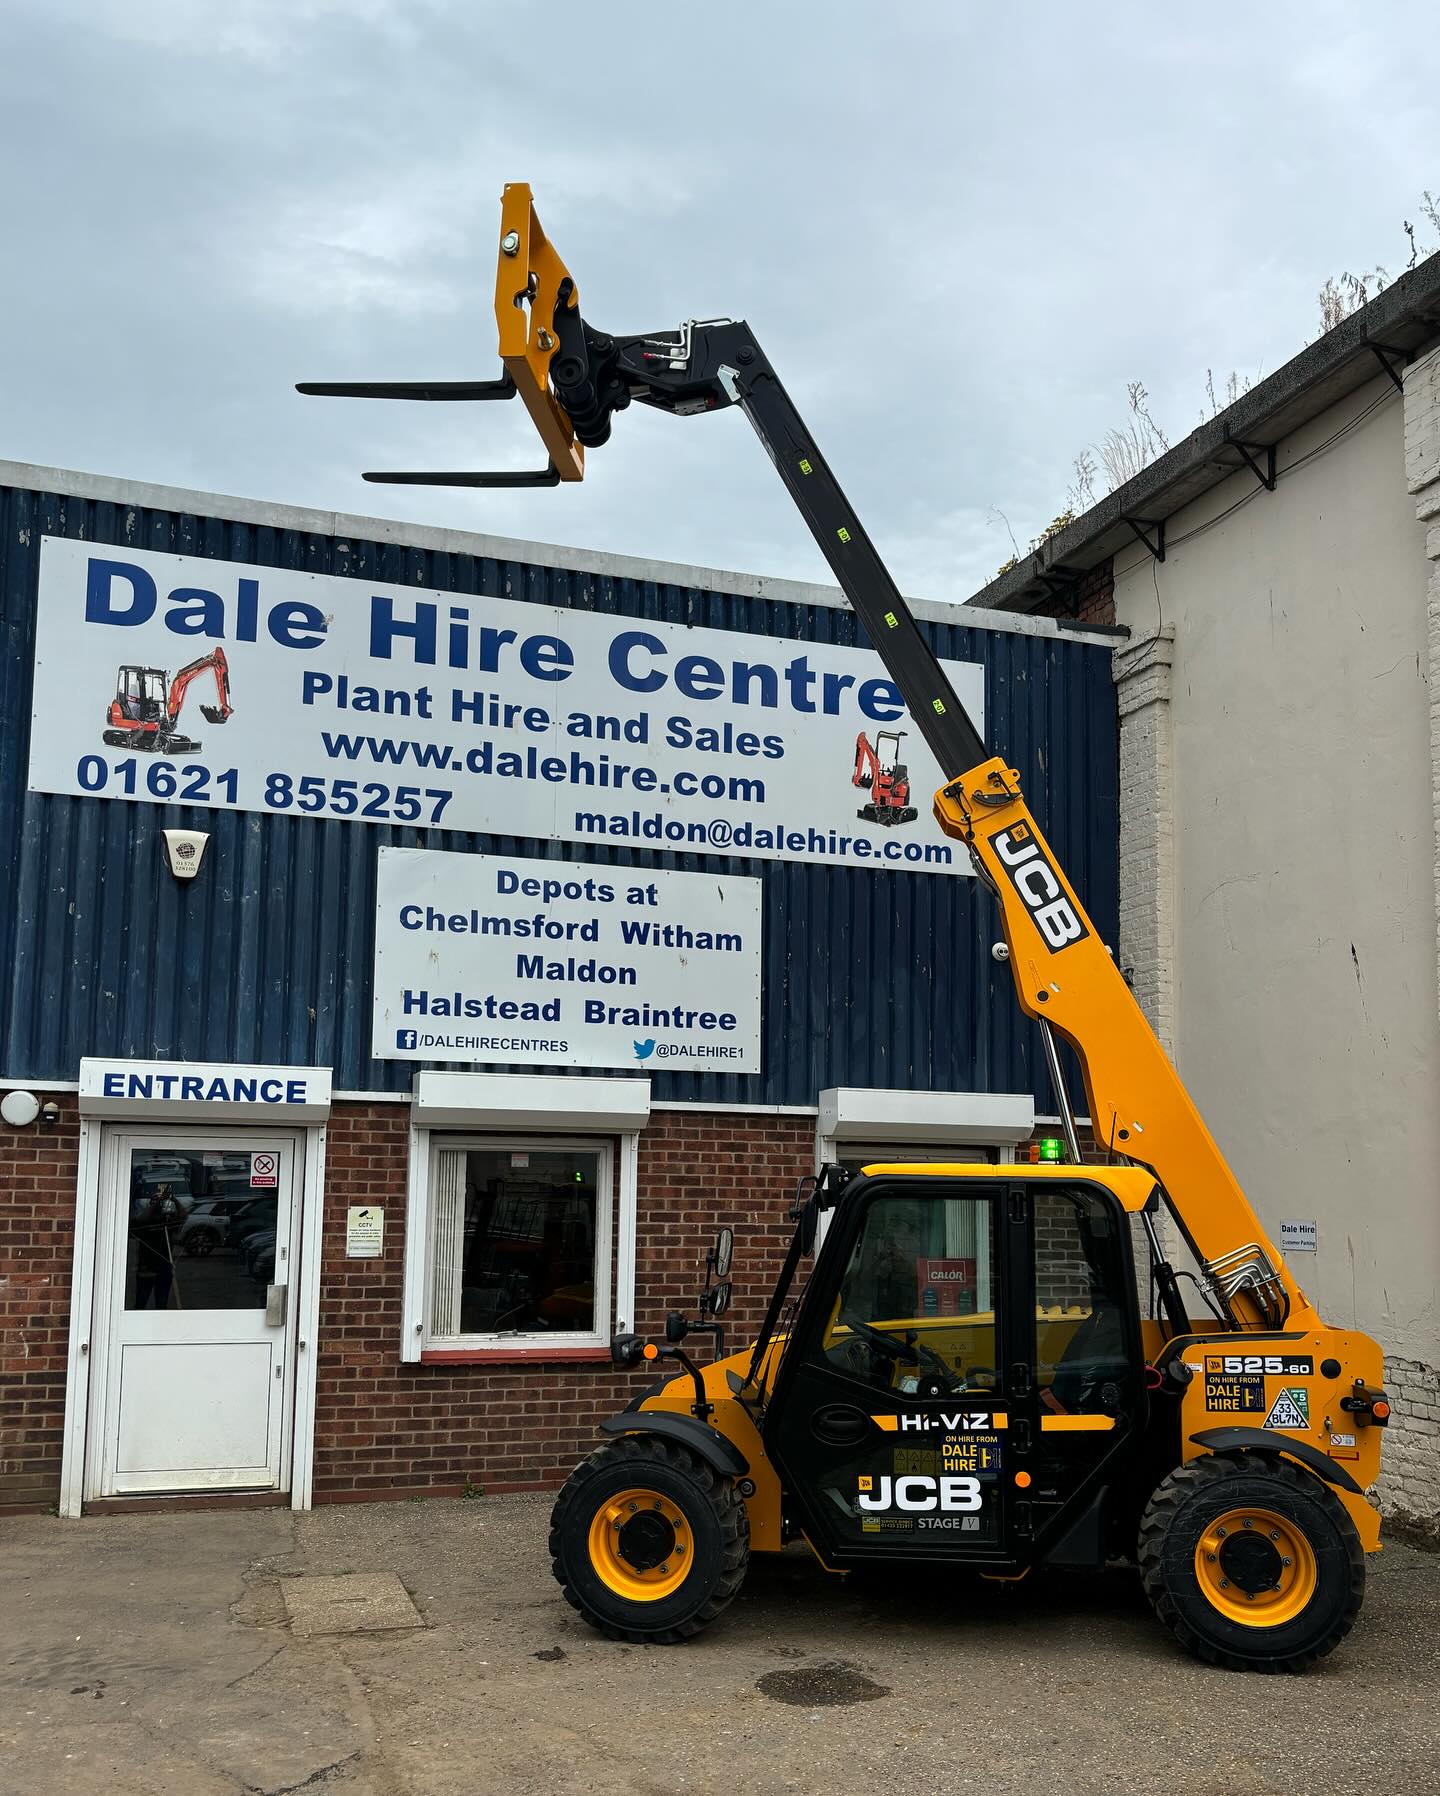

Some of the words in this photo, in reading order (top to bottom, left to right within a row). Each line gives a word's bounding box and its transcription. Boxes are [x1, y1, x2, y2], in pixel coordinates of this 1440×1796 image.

[84, 557, 328, 650] Dale
[369, 595, 575, 682] Hire
[607, 631, 906, 722] Centre
[302, 670, 433, 719] Plant
[451, 688, 551, 733] Hire
[566, 711, 649, 745] and
[665, 716, 785, 760] Sales
[320, 731, 766, 804] www.dalehire.com
[76, 754, 239, 804] 01621
[264, 772, 453, 824] 855257
[575, 811, 953, 865] maldon@dalehire.com
[497, 869, 615, 904] Depots
[626, 883, 659, 907] at
[995, 832, 1082, 948] JCB
[399, 904, 599, 942] Chelmsford
[620, 920, 743, 952] Witham
[516, 953, 637, 986] Maldon
[403, 989, 562, 1022] Halstead
[584, 999, 738, 1031] Braintree
[656, 1043, 744, 1060] @DALEHIRE1
[103, 1073, 307, 1104] ENTRANCE
[1281, 1224, 1298, 1233] Dale
[1299, 1224, 1315, 1234] Hire
[1209, 1376, 1220, 1384] ON
[1221, 1376, 1239, 1384] HIRE
[1239, 1376, 1260, 1384] FROM
[1224, 1357, 1310, 1374] 525-60
[1206, 1385, 1241, 1397] DALE
[1208, 1398, 1241, 1410] HIRE
[1278, 1403, 1292, 1414] 33
[942, 1444, 978, 1457] DALE
[945, 1435, 957, 1443] ON
[958, 1435, 975, 1443] HIRE
[976, 1435, 998, 1443] FROM
[944, 1458, 977, 1471] HIRE
[859, 1475, 983, 1511] JCB
[917, 1517, 961, 1530] STAGE
